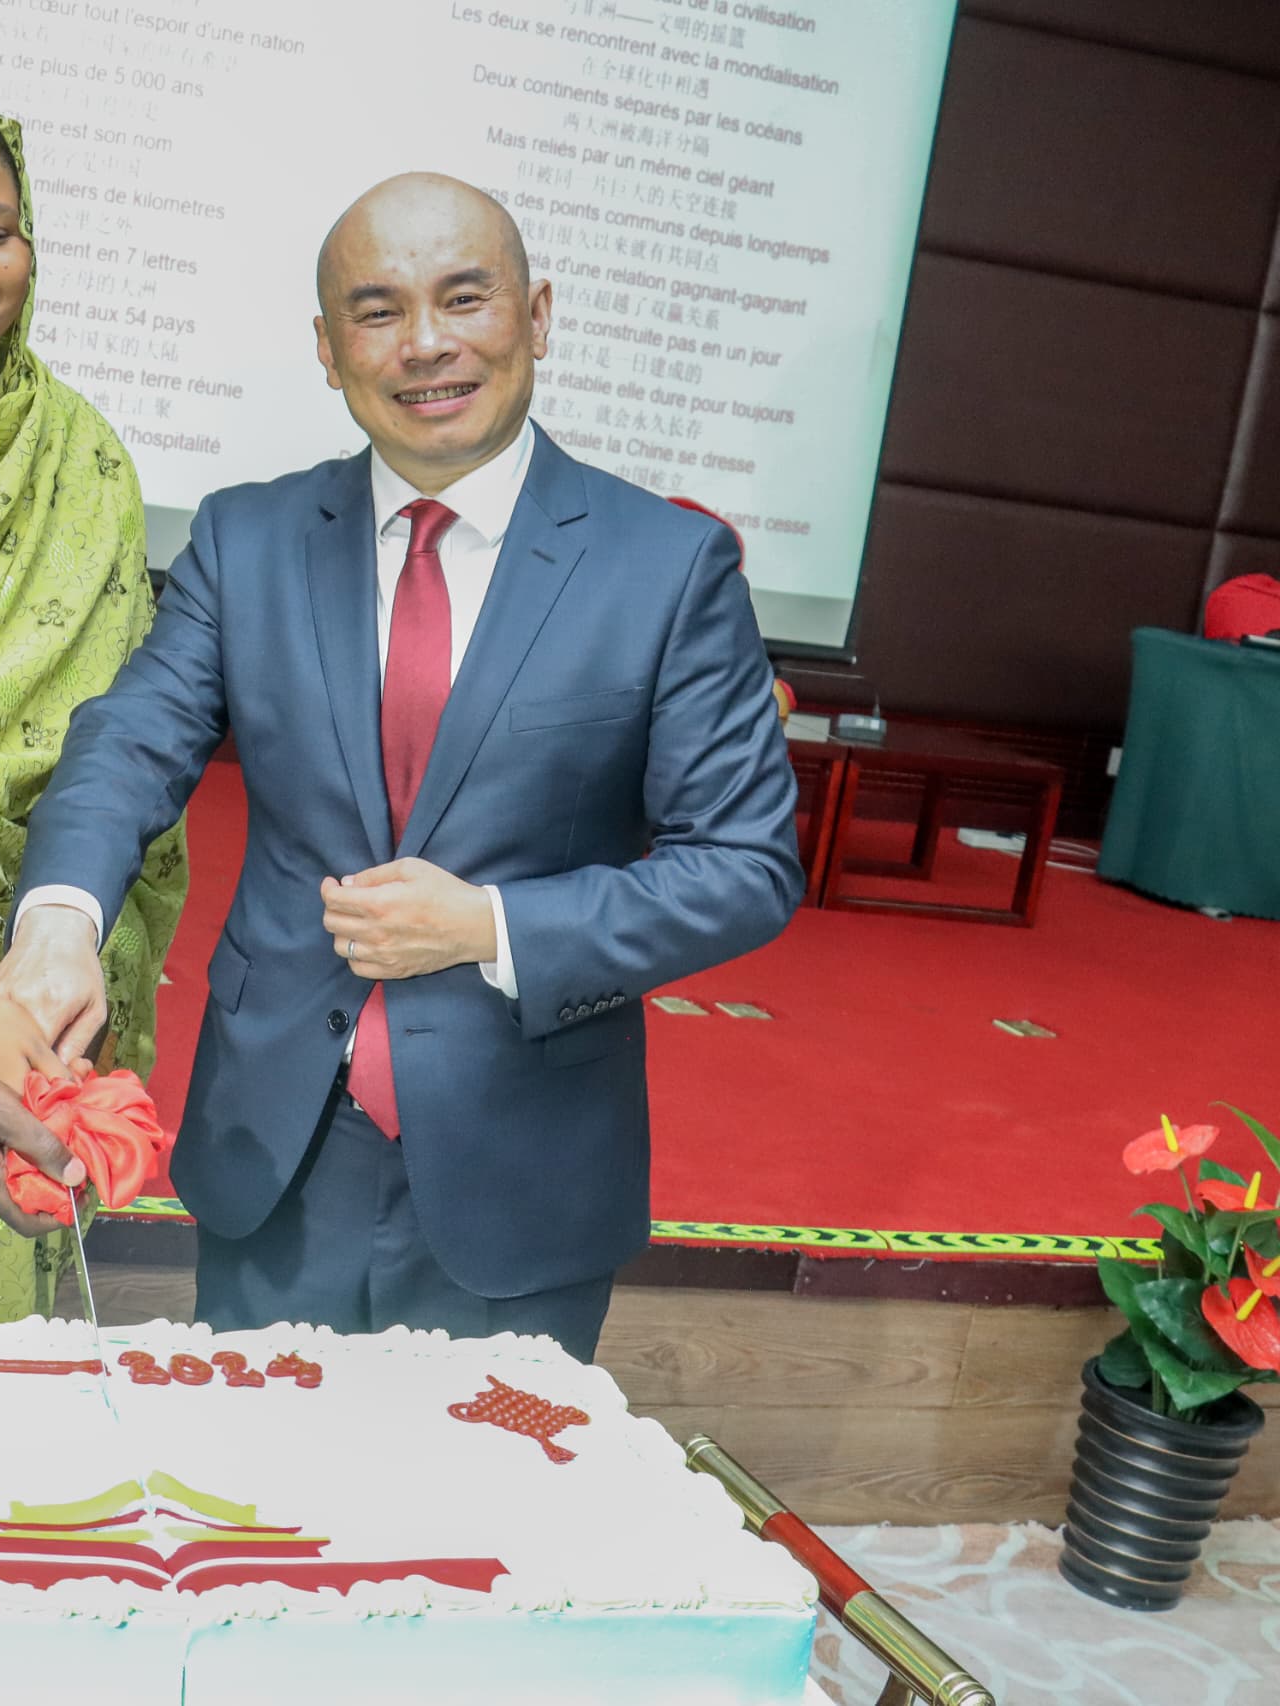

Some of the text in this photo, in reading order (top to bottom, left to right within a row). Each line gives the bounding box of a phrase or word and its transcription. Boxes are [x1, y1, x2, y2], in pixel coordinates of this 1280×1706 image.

[83, 3, 117, 23] tout
[123, 8, 188, 34] l'espoir
[193, 21, 243, 44] d'une
[248, 33, 304, 54] nation
[732, 2, 816, 33] civilisation
[451, 1, 839, 95] Les deux se rencontrent avec la mondialisation
[11, 53, 34, 71] de
[40, 57, 78, 78] plus
[85, 64, 107, 82] de
[171, 79, 204, 97] ans
[474, 64, 803, 145] Deux continents séparés par les océans
[60, 122, 88, 139] est
[94, 128, 127, 145] son
[133, 133, 172, 153] nom
[487, 126, 775, 198] Mais reliés par un même ciel géant
[34, 176, 97, 200] milliers
[104, 187, 127, 205] de
[514, 191, 544, 210] des
[550, 197, 599, 222] points
[605, 208, 684, 238] communs
[690, 220, 742, 249] depuis
[747, 233, 830, 266] longtemps
[97, 246, 119, 264] en
[127, 247, 137, 264] 7
[143, 251, 198, 275] lettres
[556, 256, 600, 279] d'une
[606, 268, 666, 292] relation
[671, 279, 807, 316] gagnant-gagnant
[86, 305, 118, 322] aux
[125, 307, 147, 326] 54
[152, 314, 195, 335] pays
[558, 316, 782, 369] se construite pas en un jour
[77, 361, 134, 383] même
[140, 369, 182, 390] terre
[187, 376, 243, 399] réunie
[558, 370, 611, 394] établie
[617, 380, 644, 400] elle
[650, 385, 687, 408] dure
[690, 394, 727, 415] pour
[731, 400, 795, 425] toujours
[122, 424, 221, 455] l'hospitalité
[607, 432, 621, 453] la
[626, 438, 673, 463] Chine
[678, 448, 697, 465] se
[702, 451, 755, 474] dresse
[765, 517, 810, 536] cesse
[118, 1350, 322, 1389] 2024
